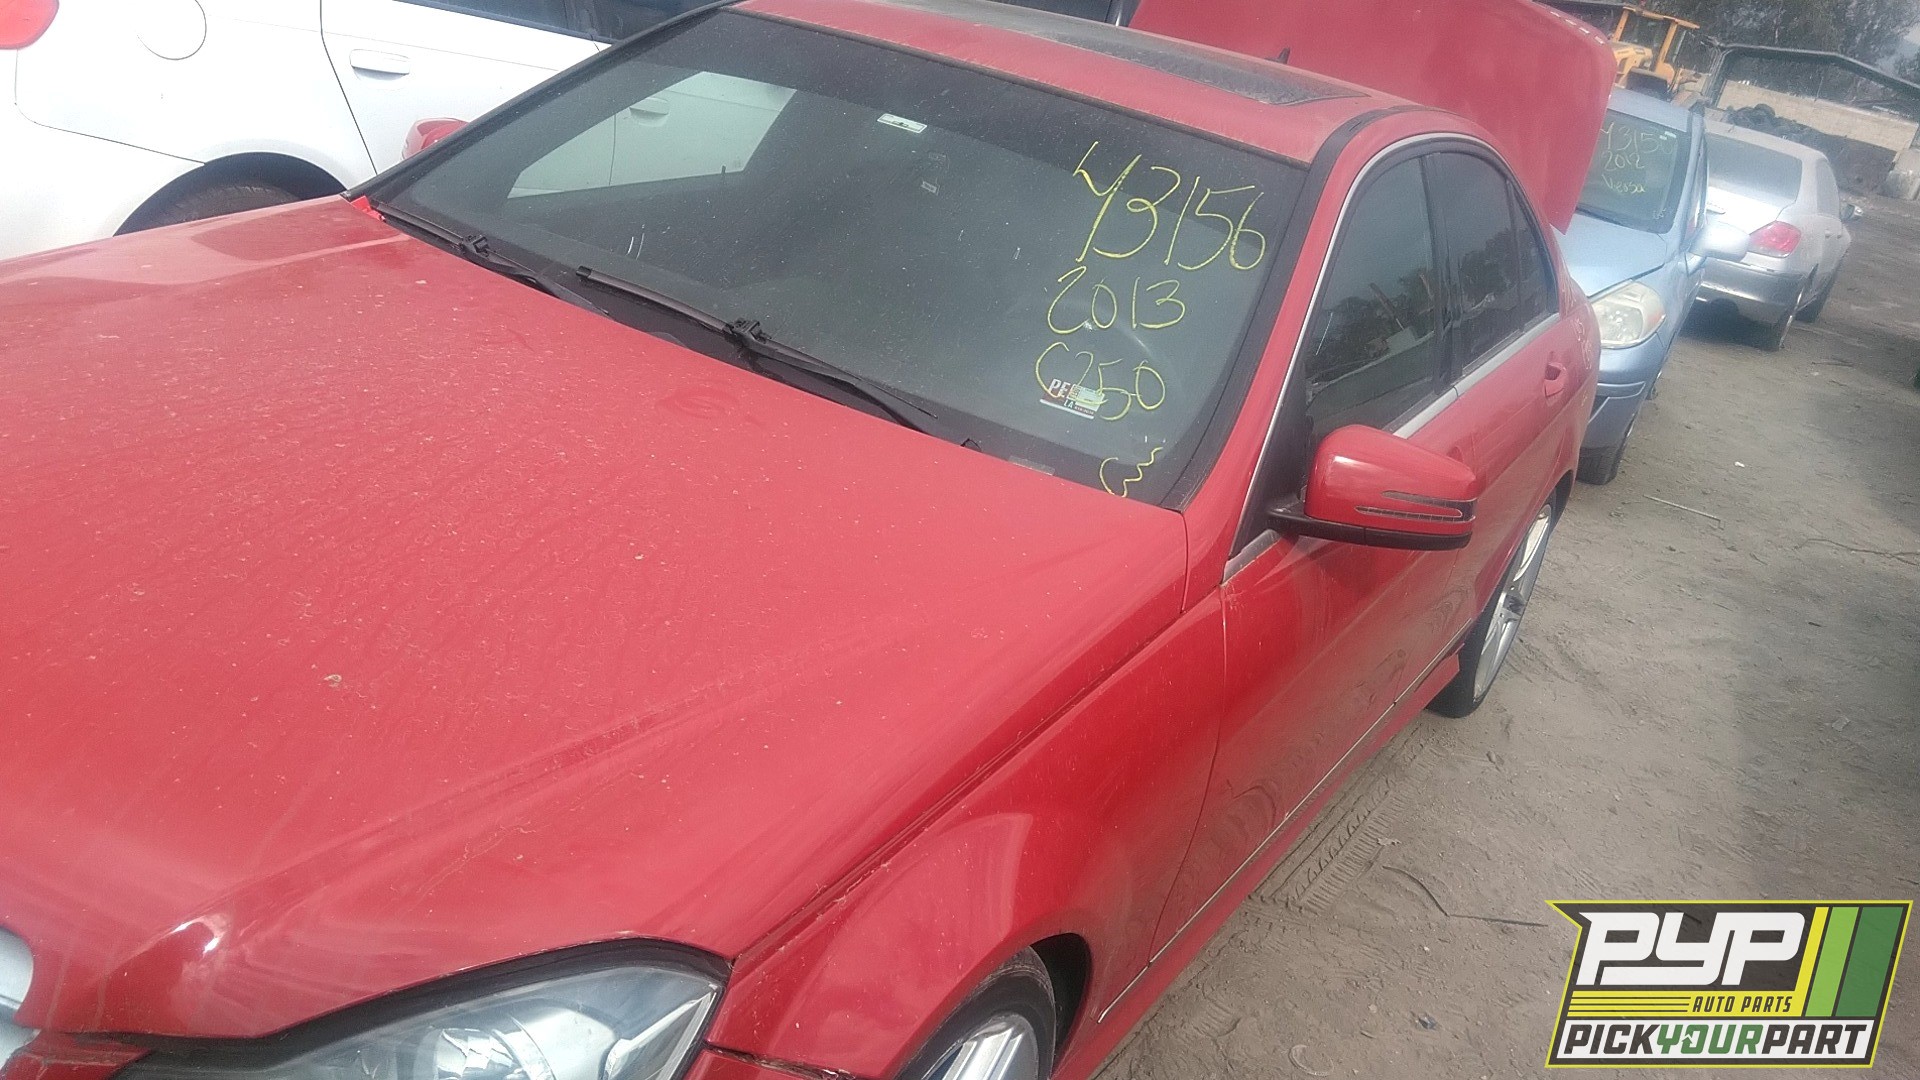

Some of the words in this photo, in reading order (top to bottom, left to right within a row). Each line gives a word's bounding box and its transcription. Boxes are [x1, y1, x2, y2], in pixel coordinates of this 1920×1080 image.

[1602, 150, 1645, 171] 2012
[1073, 141, 1266, 271] 43156
[1047, 265, 1186, 334] 2013
[1035, 341, 1166, 421] C250
